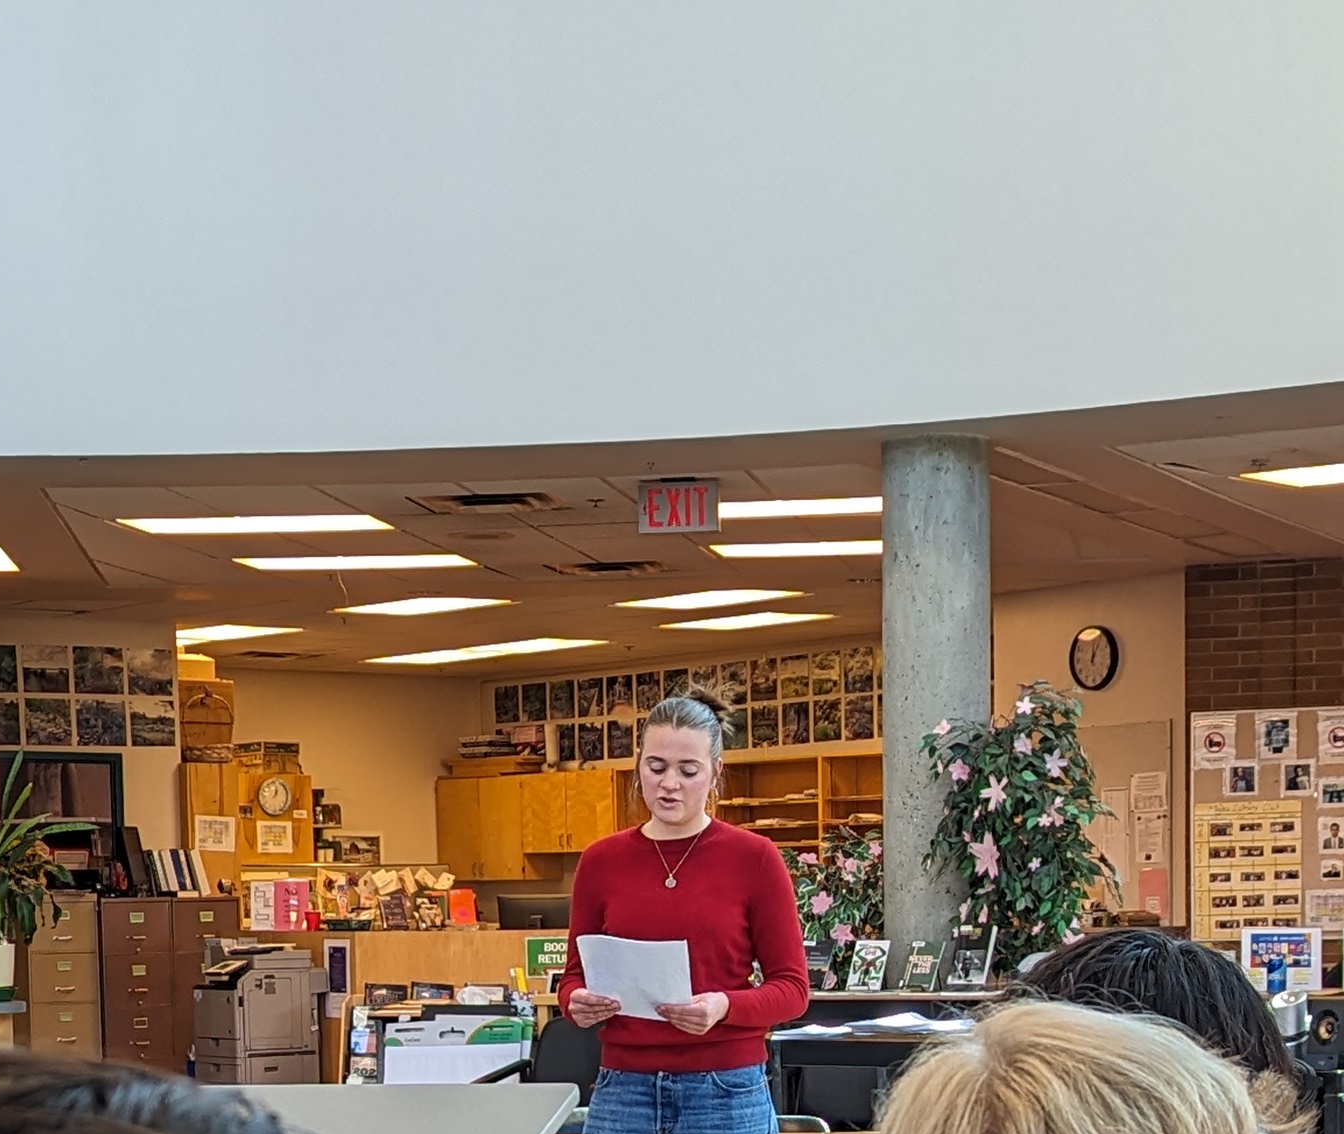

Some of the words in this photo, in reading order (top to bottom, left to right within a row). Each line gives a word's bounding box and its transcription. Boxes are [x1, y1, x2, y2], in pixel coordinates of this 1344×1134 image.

[647, 486, 709, 528] EXIT
[544, 942, 566, 952] BOO
[538, 954, 565, 964] RETU
